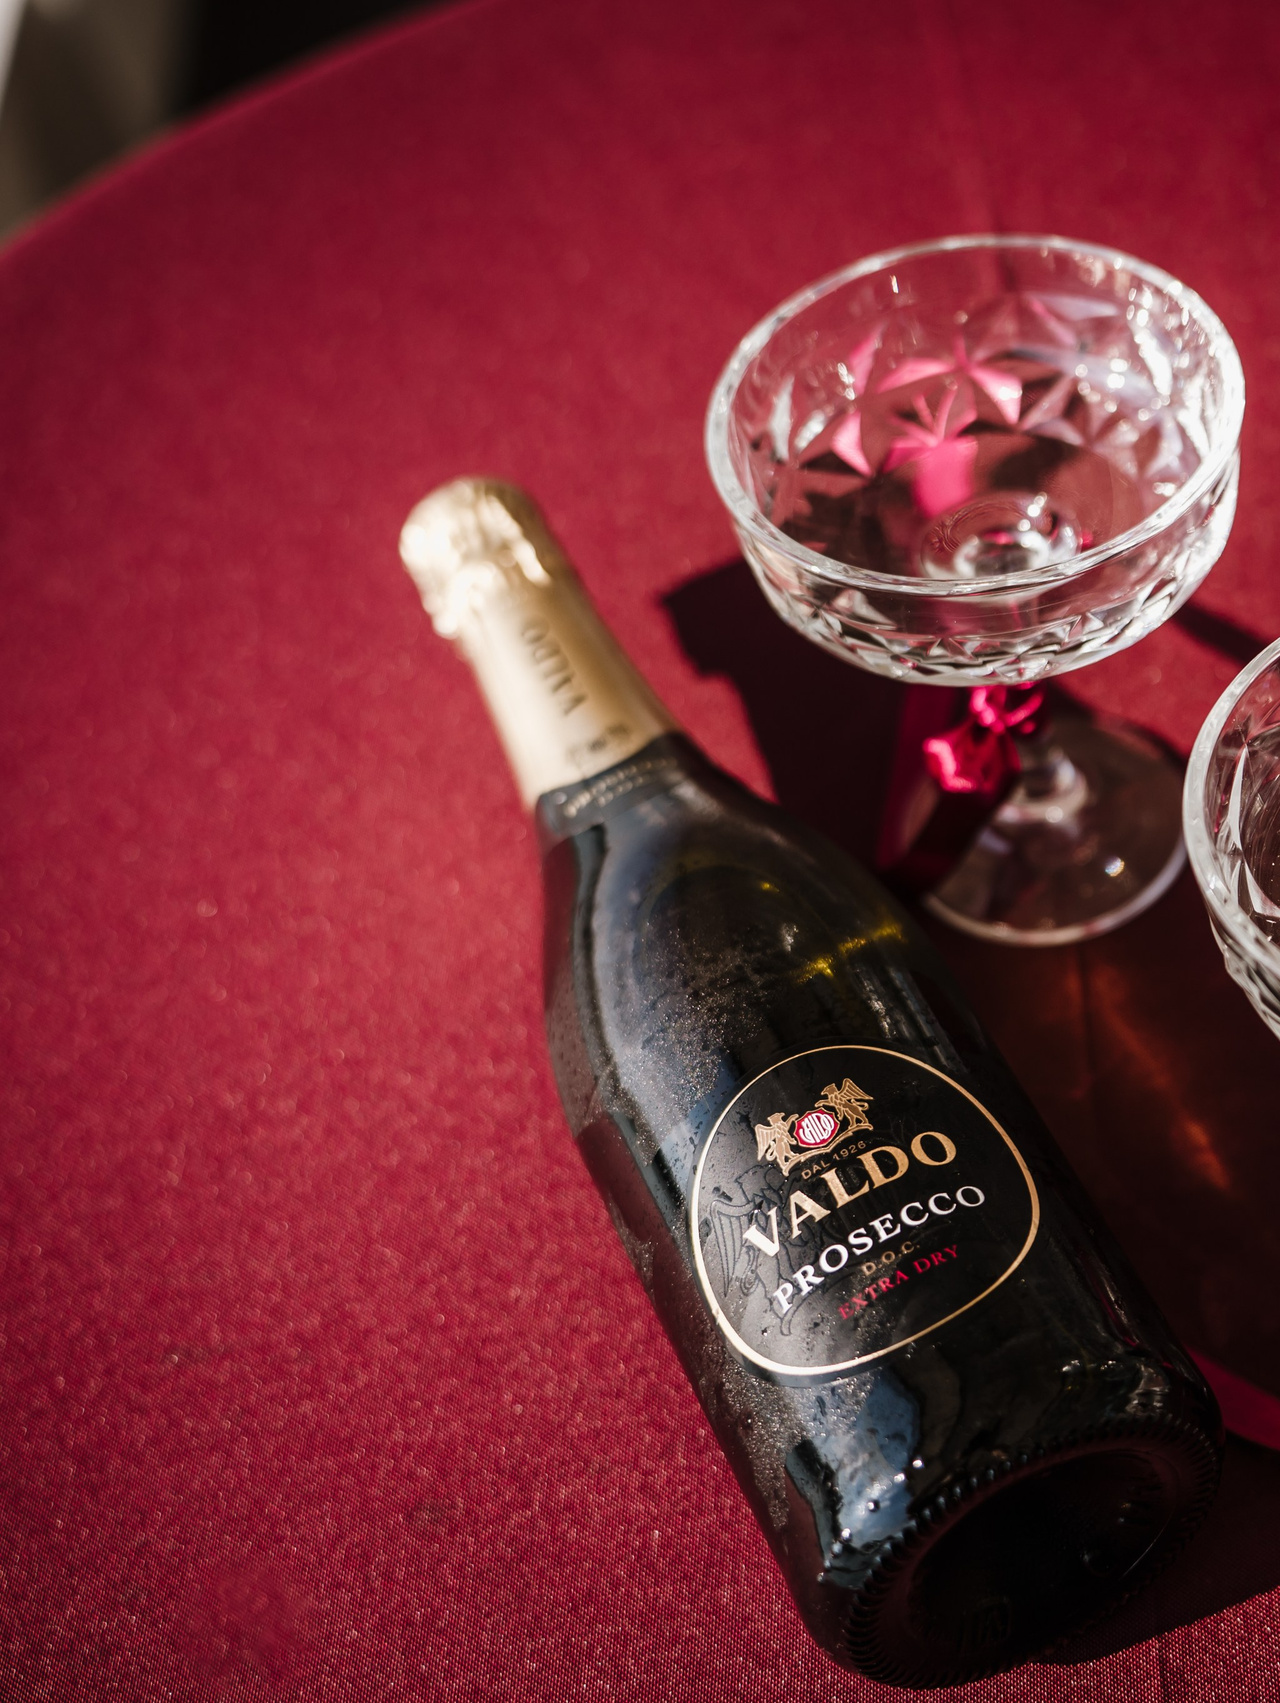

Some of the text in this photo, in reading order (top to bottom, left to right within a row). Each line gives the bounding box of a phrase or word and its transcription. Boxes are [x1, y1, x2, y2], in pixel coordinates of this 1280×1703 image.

[522, 616, 587, 714] VALDO
[743, 1131, 957, 1257] VALDO
[801, 1140, 867, 1180] DAL 1926
[772, 1185, 985, 1313] PROSECCO
[837, 1245, 959, 1320] EXTRA DRY
[861, 1241, 919, 1277] D.O.C.
